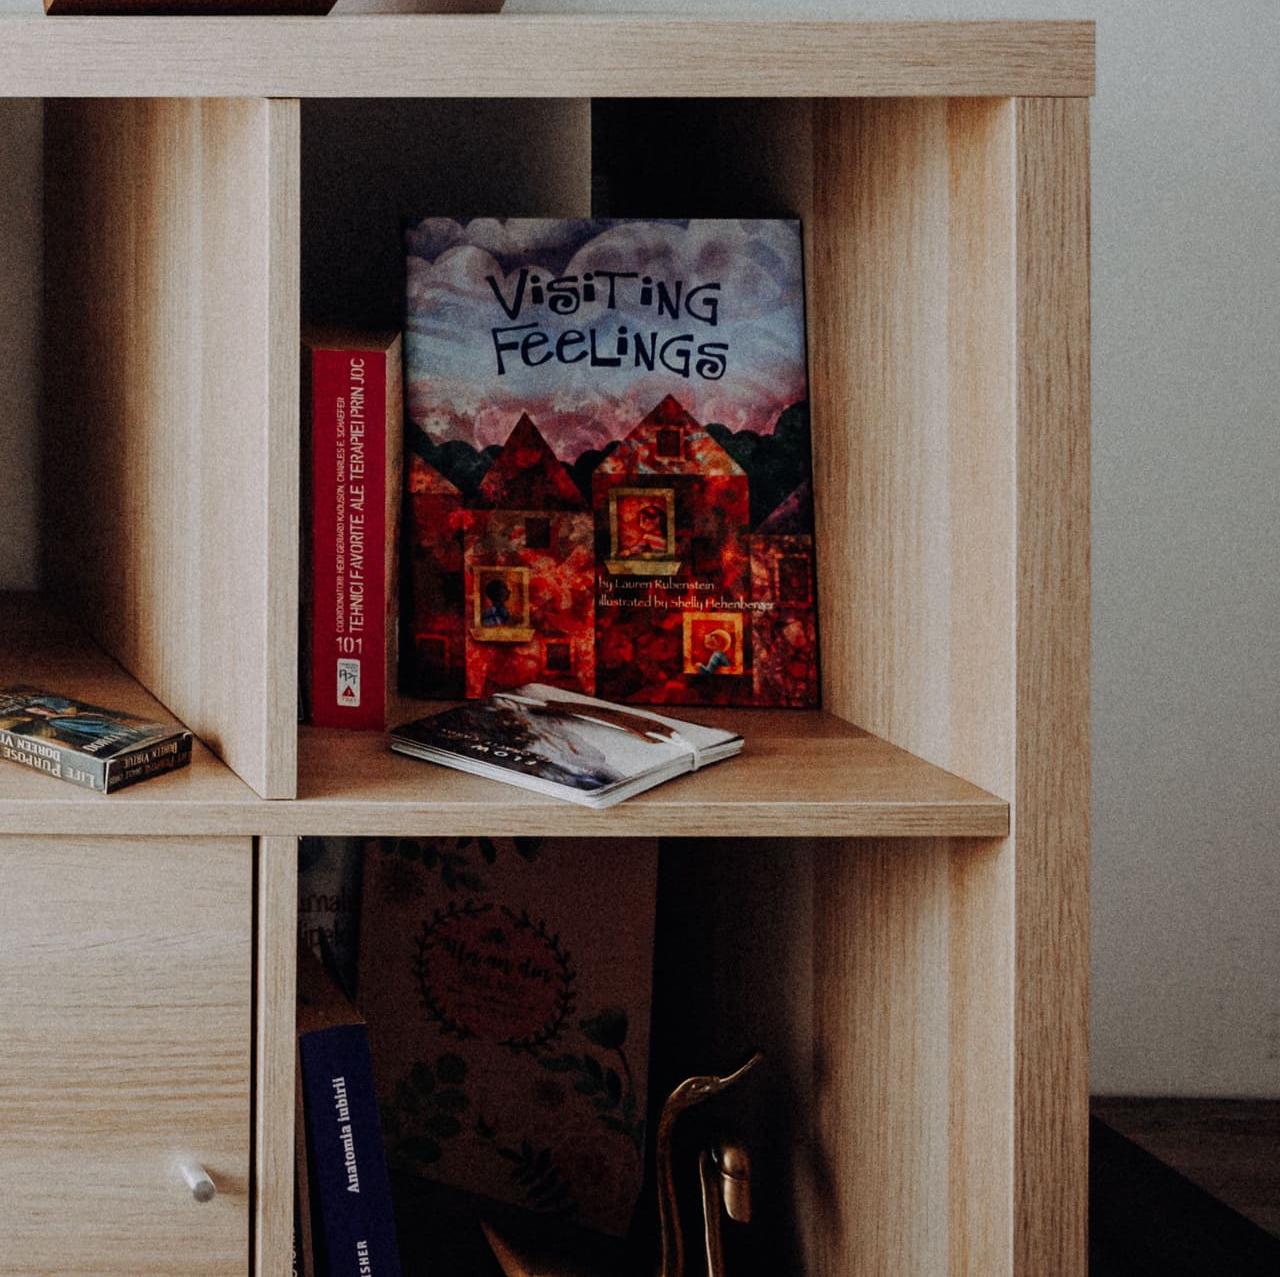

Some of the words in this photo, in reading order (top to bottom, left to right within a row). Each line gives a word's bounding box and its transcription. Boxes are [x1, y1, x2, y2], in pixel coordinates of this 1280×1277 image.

[350, 358, 364, 384] JOC
[350, 387, 364, 418] PRIN
[350, 421, 364, 480] TERAPIEI
[350, 486, 364, 511] ALE
[350, 515, 364, 579] FAVORITE
[598, 575, 613, 592] by
[615, 578, 653, 590] Lauren
[350, 583, 364, 633] TEHNICI
[598, 594, 652, 608] illustrated
[653, 595, 668, 610] by
[336, 636, 362, 654] 101
[16, 738, 60, 762] DOREEN
[332, 1076, 351, 1122] iubirii
[338, 1125, 360, 1193] Anatomia
[356, 1240, 372, 1277] ISHER
